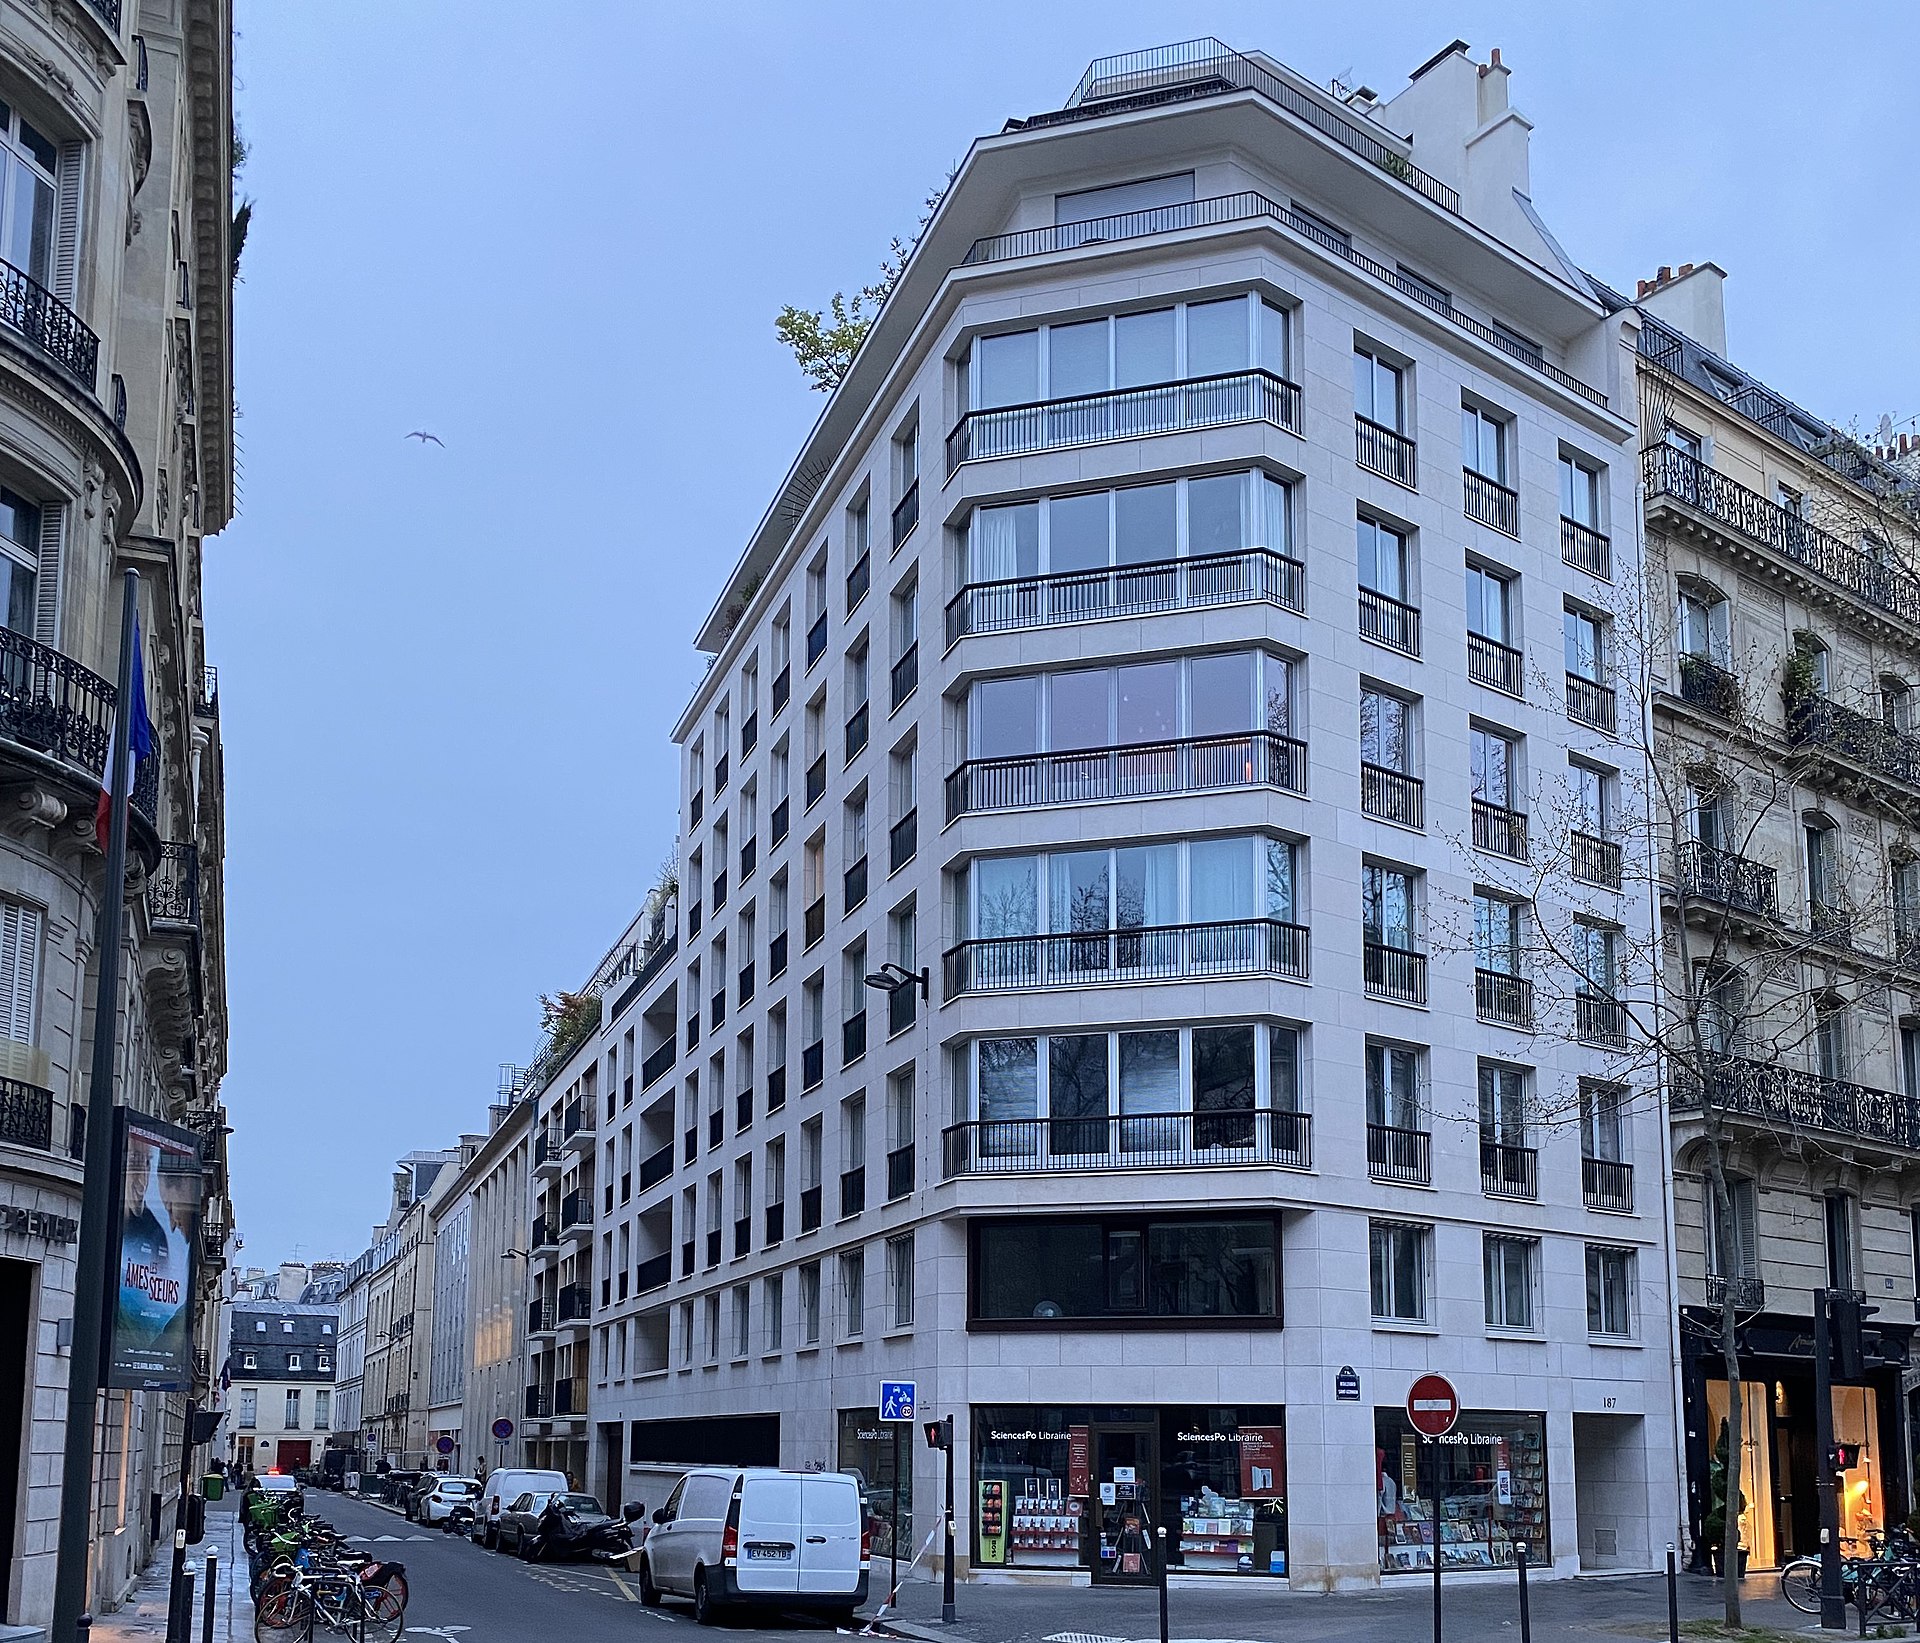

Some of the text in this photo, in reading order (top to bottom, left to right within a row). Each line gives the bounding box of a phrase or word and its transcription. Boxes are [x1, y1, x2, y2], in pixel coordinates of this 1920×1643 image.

[125, 1257, 149, 1290] ÂMES
[148, 1276, 180, 1305] SŒURS
[1603, 1397, 1616, 1409] 187
[990, 1430, 1037, 1440] SciencesPo
[1038, 1431, 1072, 1440] Librairie
[1177, 1431, 1264, 1442] SciencesPo Librairie
[1422, 1431, 1503, 1445] ScncesPo Librairie
